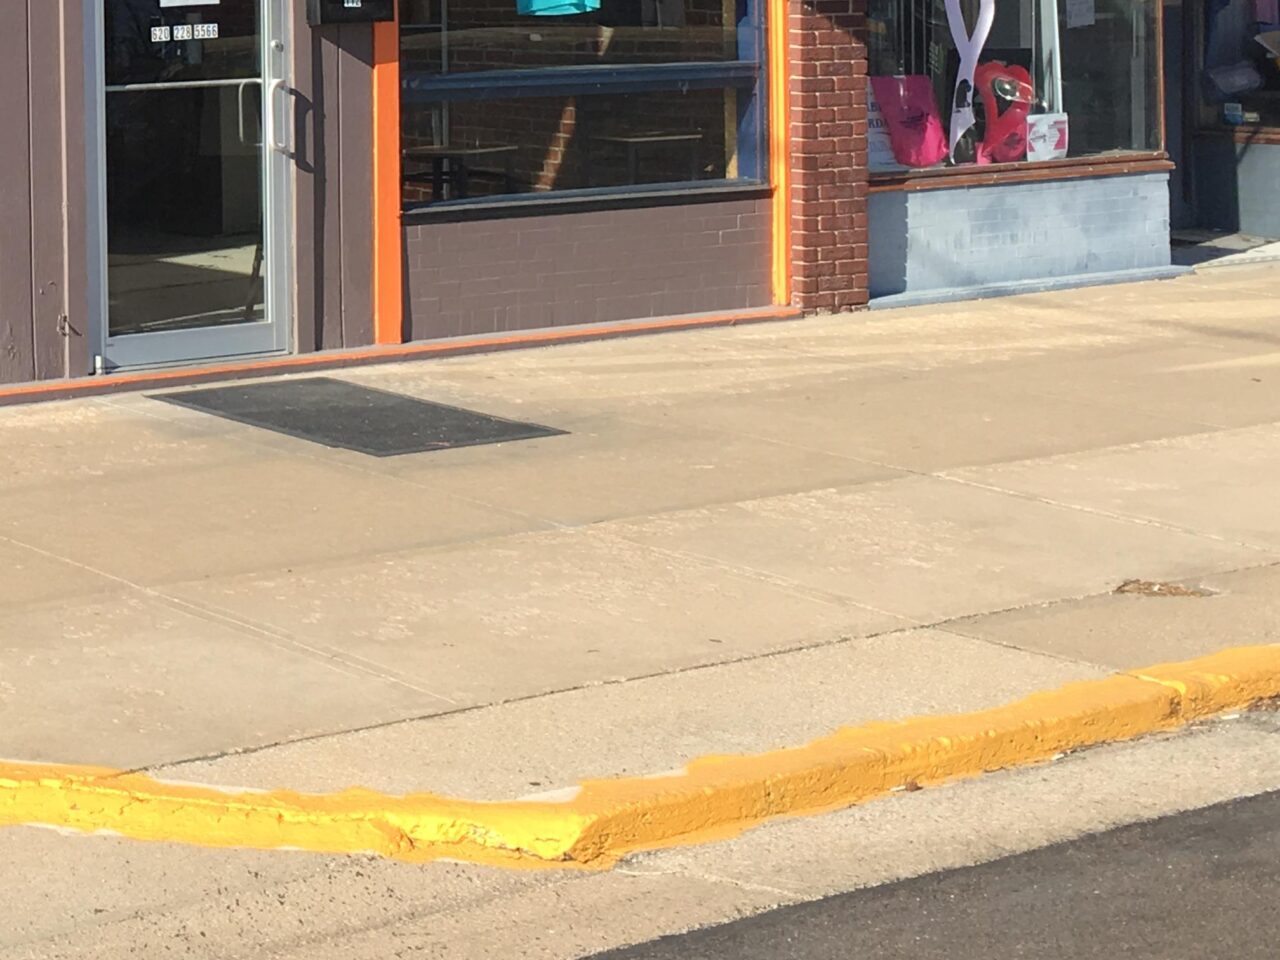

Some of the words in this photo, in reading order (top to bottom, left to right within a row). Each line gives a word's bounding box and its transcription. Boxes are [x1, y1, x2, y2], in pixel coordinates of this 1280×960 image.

[151, 27, 170, 41] 620
[174, 25, 192, 39] 228
[194, 24, 218, 38] 5566
